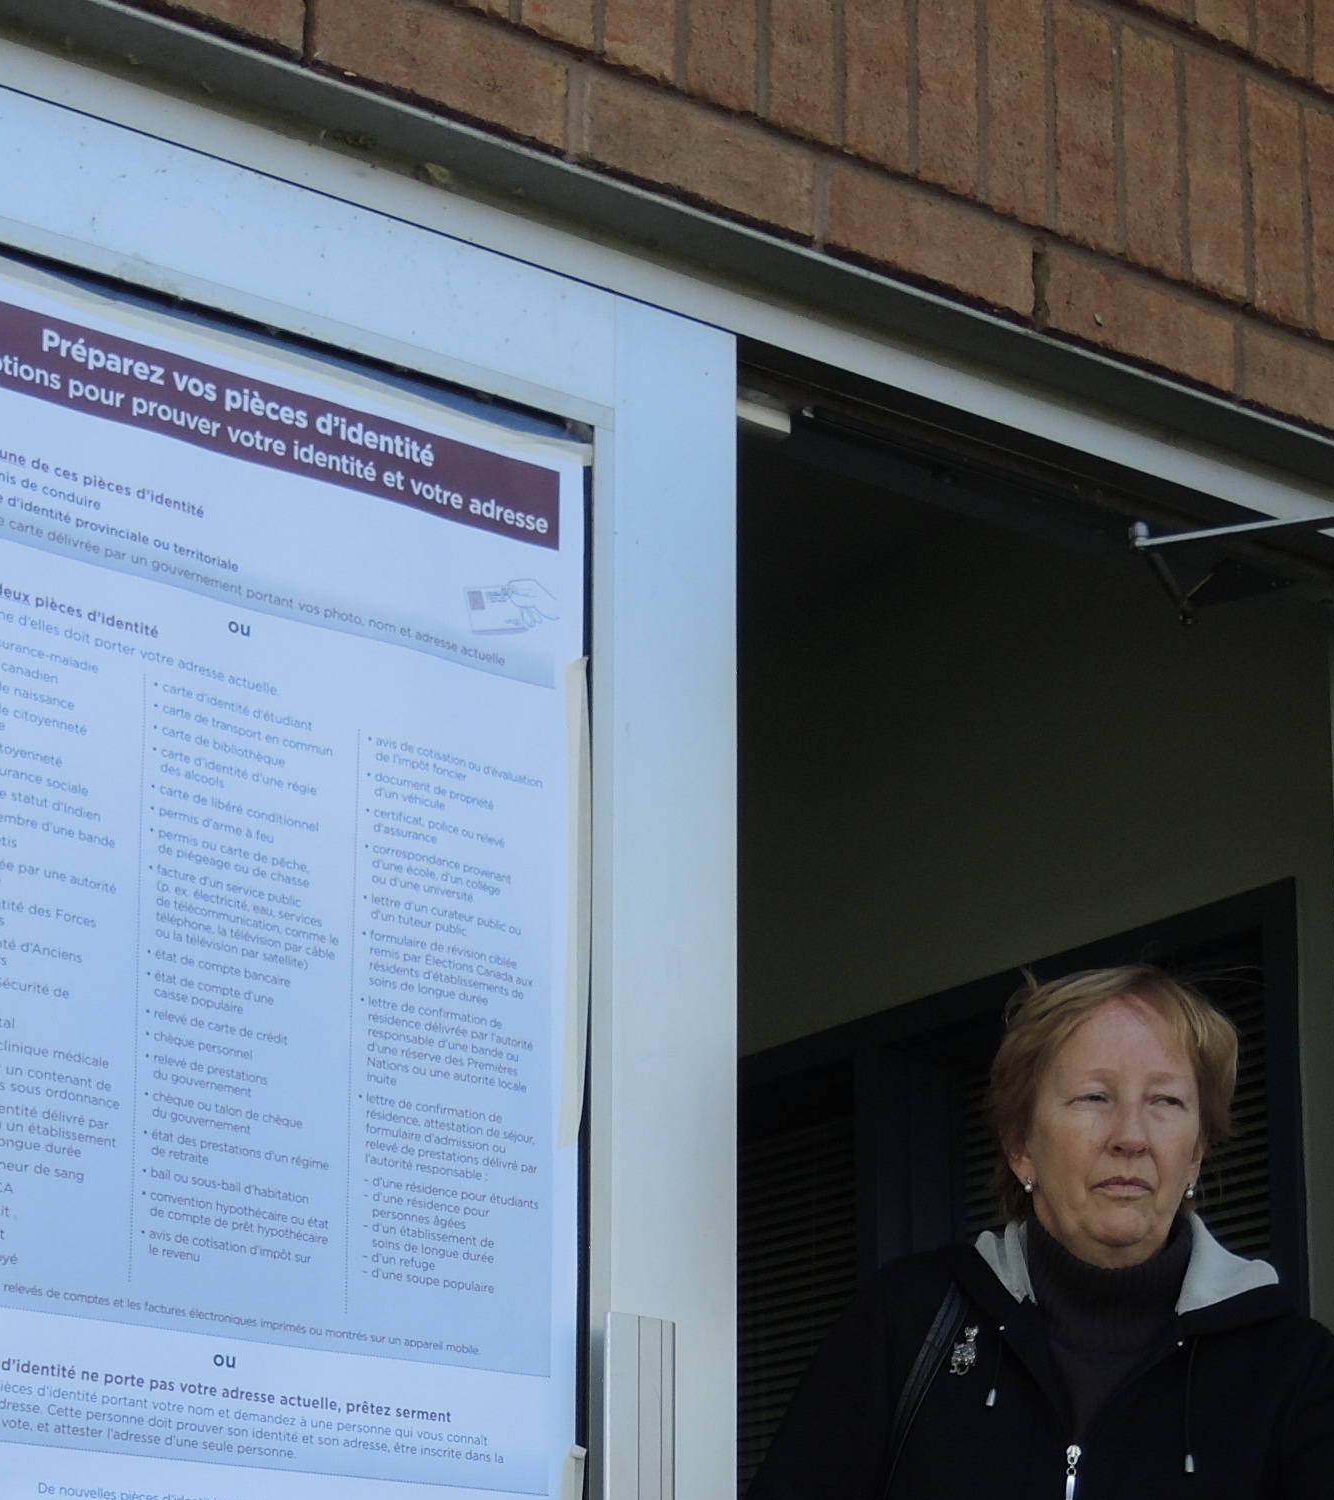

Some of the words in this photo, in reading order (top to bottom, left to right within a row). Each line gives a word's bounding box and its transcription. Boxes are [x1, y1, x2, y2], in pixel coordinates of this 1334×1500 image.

[41, 327, 165, 386] Préparez
[172, 370, 217, 402] vos
[224, 387, 308, 429] pièces
[315, 412, 435, 467] d'identité
[68, 378, 125, 408] pour
[131, 395, 221, 438] prouver
[226, 425, 287, 456] votre
[293, 439, 377, 482] identité
[382, 470, 405, 491] et
[409, 478, 464, 510] votre
[468, 497, 549, 534] adresse
[20, 477, 38, 492] de
[41, 485, 101, 511] conduire
[30, 457, 50, 473] de
[53, 466, 78, 482] ces
[82, 474, 131, 496] pièces
[135, 487, 204, 519] d'identité
[6, 495, 72, 525] d'identité
[74, 517, 150, 545] provinciale
[153, 539, 170, 552] ou
[173, 541, 240, 574] territoriale
[34, 595, 83, 618] pièces
[86, 609, 159, 639] d'identité
[227, 620, 251, 637] ou
[0, 661, 59, 684] canadien
[153, 1030, 195, 1050] chèque
[197, 1041, 253, 1060] personnel
[370, 1267, 403, 1282] d'une
[405, 1273, 440, 1287] soupe
[442, 1278, 495, 1294] populaire
[212, 1353, 236, 1369] ou
[0, 1357, 76, 1380] d'identité
[80, 1369, 99, 1383] ne
[103, 1372, 145, 1388] porte
[149, 1378, 175, 1392] pas
[179, 1382, 217, 1397] votre
[221, 1386, 275, 1404] adresse
[279, 1394, 341, 1414] actuelle,
[345, 1400, 391, 1417] prêtez
[395, 1407, 451, 1423] serment
